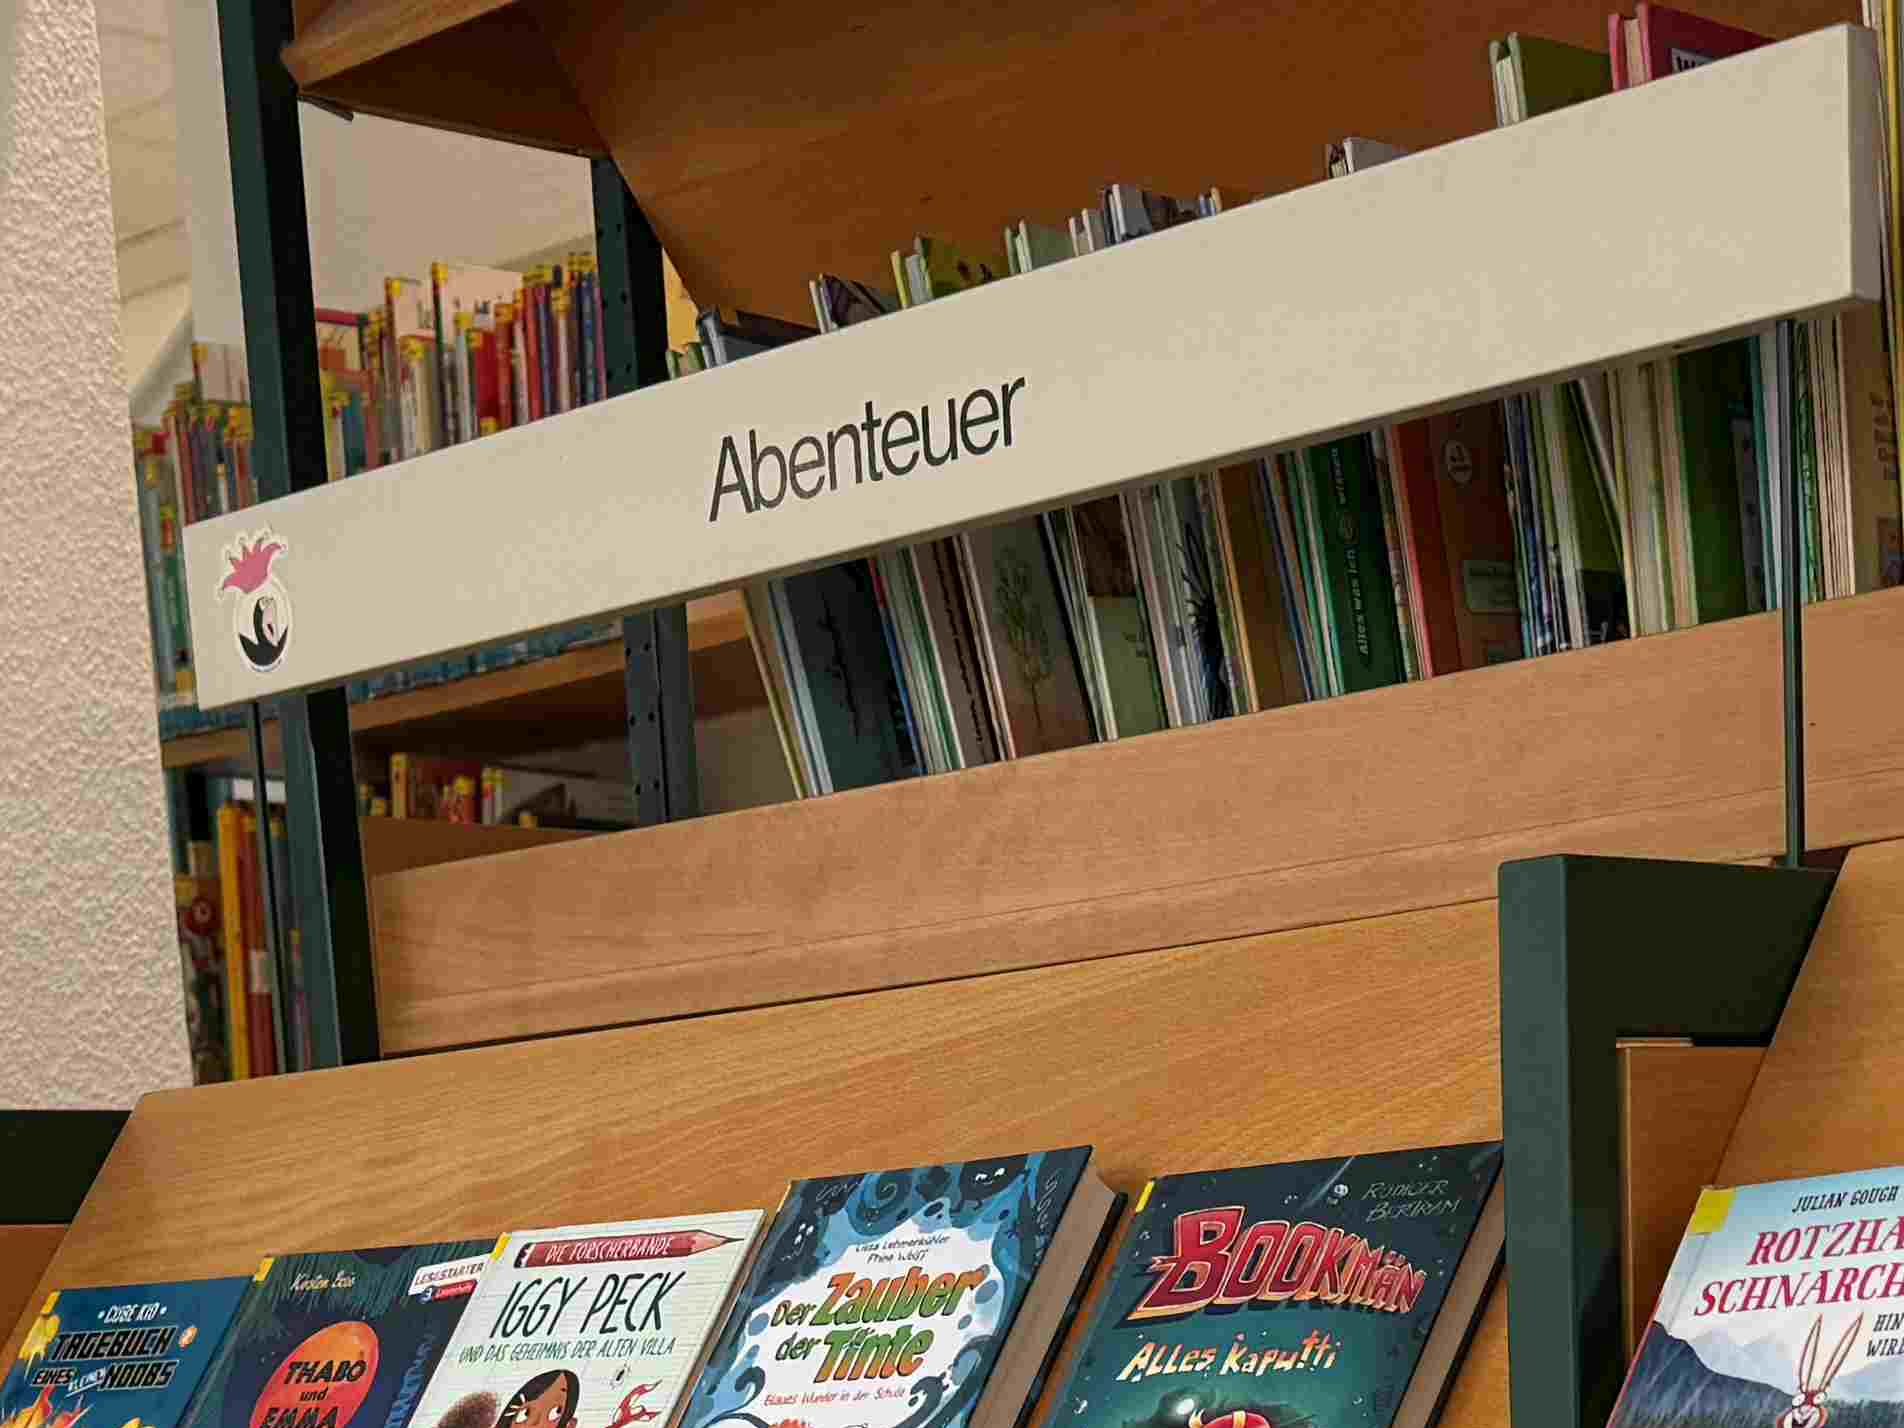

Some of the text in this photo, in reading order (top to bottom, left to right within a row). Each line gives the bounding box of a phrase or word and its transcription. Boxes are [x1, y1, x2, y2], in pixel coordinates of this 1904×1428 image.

[708, 376, 1026, 522] Abenteuer
[1791, 1191, 1846, 1214] JULIAN
[1850, 1184, 1899, 1206] GOUGH
[545, 1235, 673, 1262] DIE FORSCHERBANDE
[1127, 1205, 1427, 1321] BOOKMÄN
[489, 1270, 688, 1338] IGGY PECK
[770, 1263, 991, 1327] Der Zauber
[52, 1326, 178, 1360] TAGEBUCH
[458, 1336, 676, 1364] UND DAS GEHEIMNIS DER ALTEN VILLA
[775, 1324, 935, 1384] der Tinte
[97, 1360, 179, 1391] NOOBS
[283, 1359, 368, 1385] THABO
[1115, 1342, 1217, 1383] ALLES
[299, 1387, 328, 1402] und
